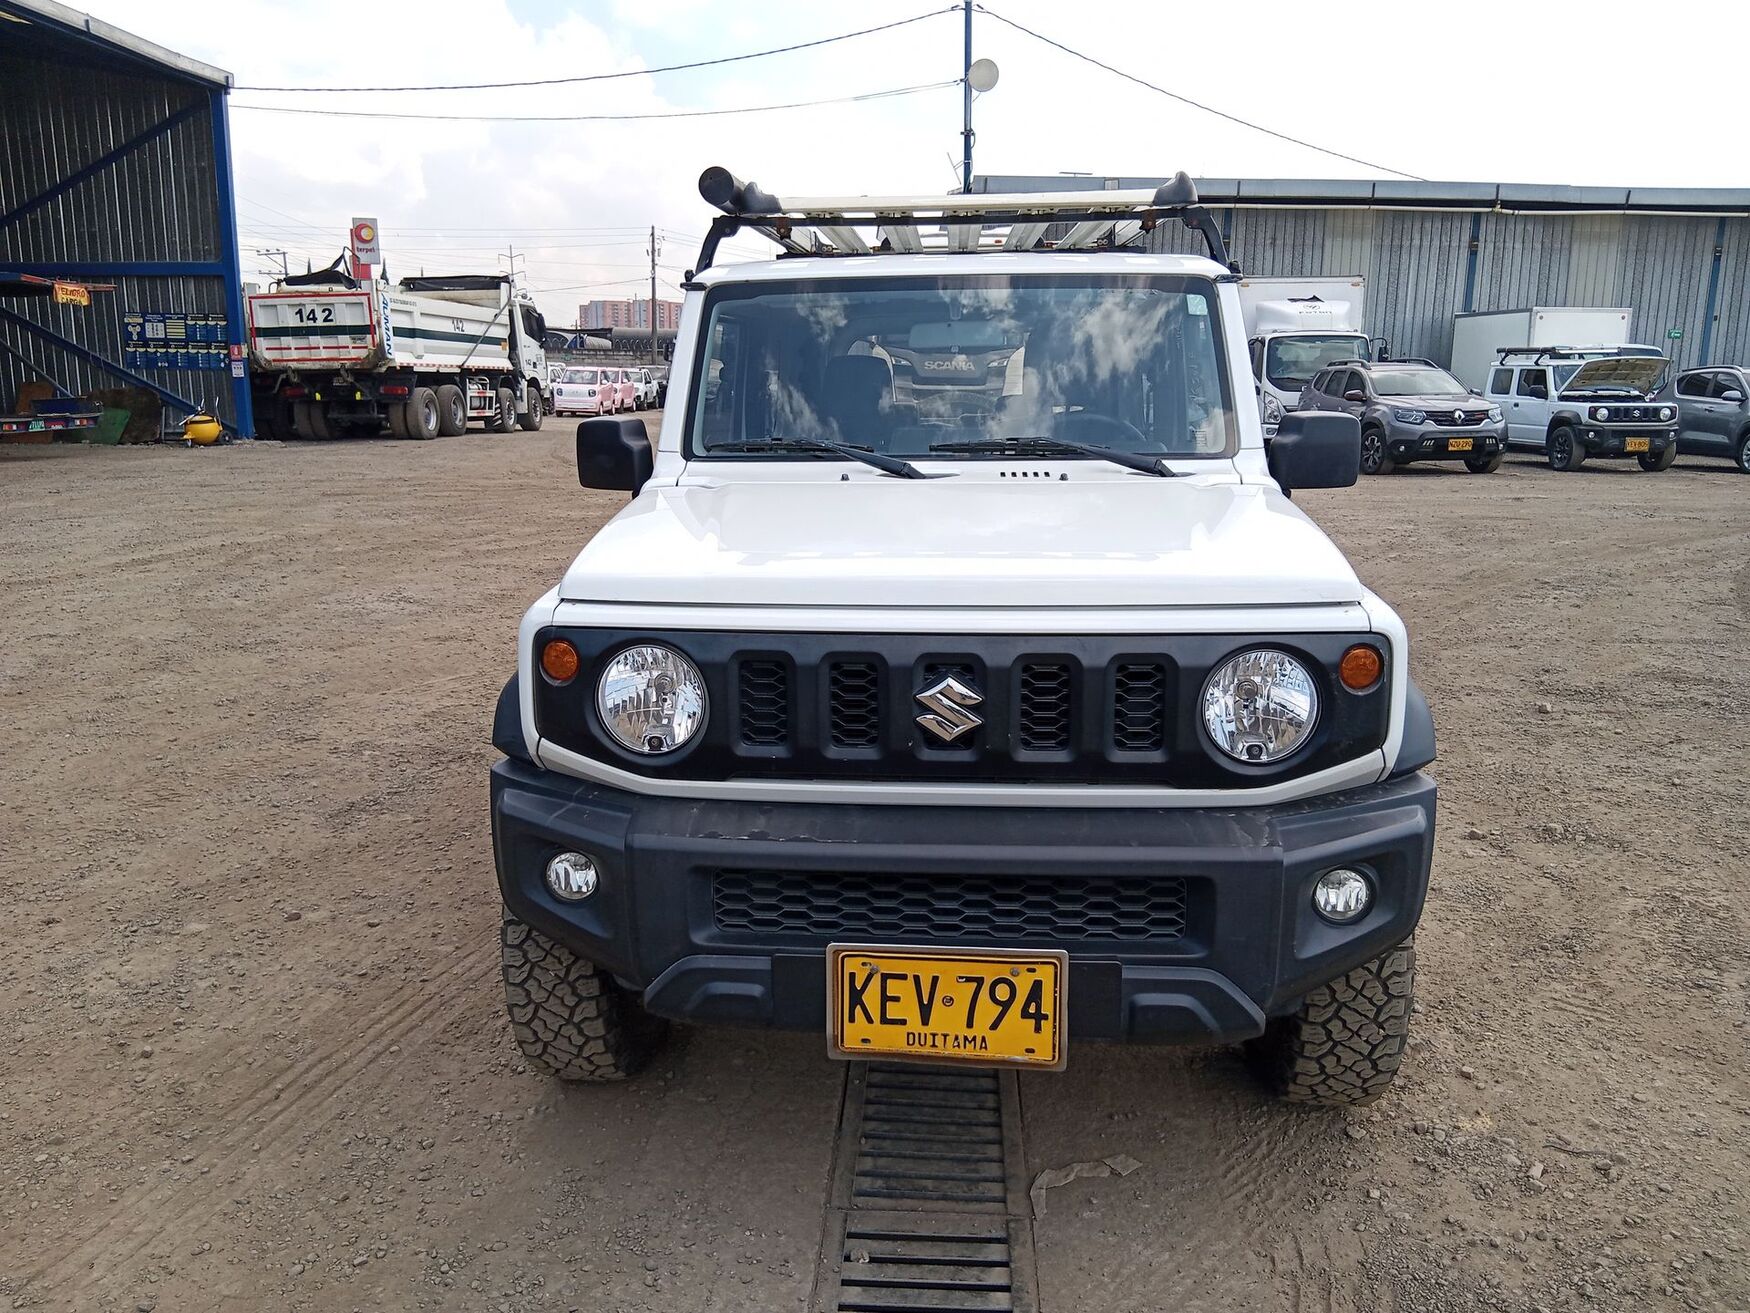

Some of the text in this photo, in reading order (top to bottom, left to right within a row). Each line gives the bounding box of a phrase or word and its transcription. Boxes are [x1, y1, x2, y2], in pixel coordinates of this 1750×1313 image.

[356, 246, 376, 254] terpel
[923, 360, 976, 371] SCANIA
[905, 1030, 989, 1052] DUITAMA
